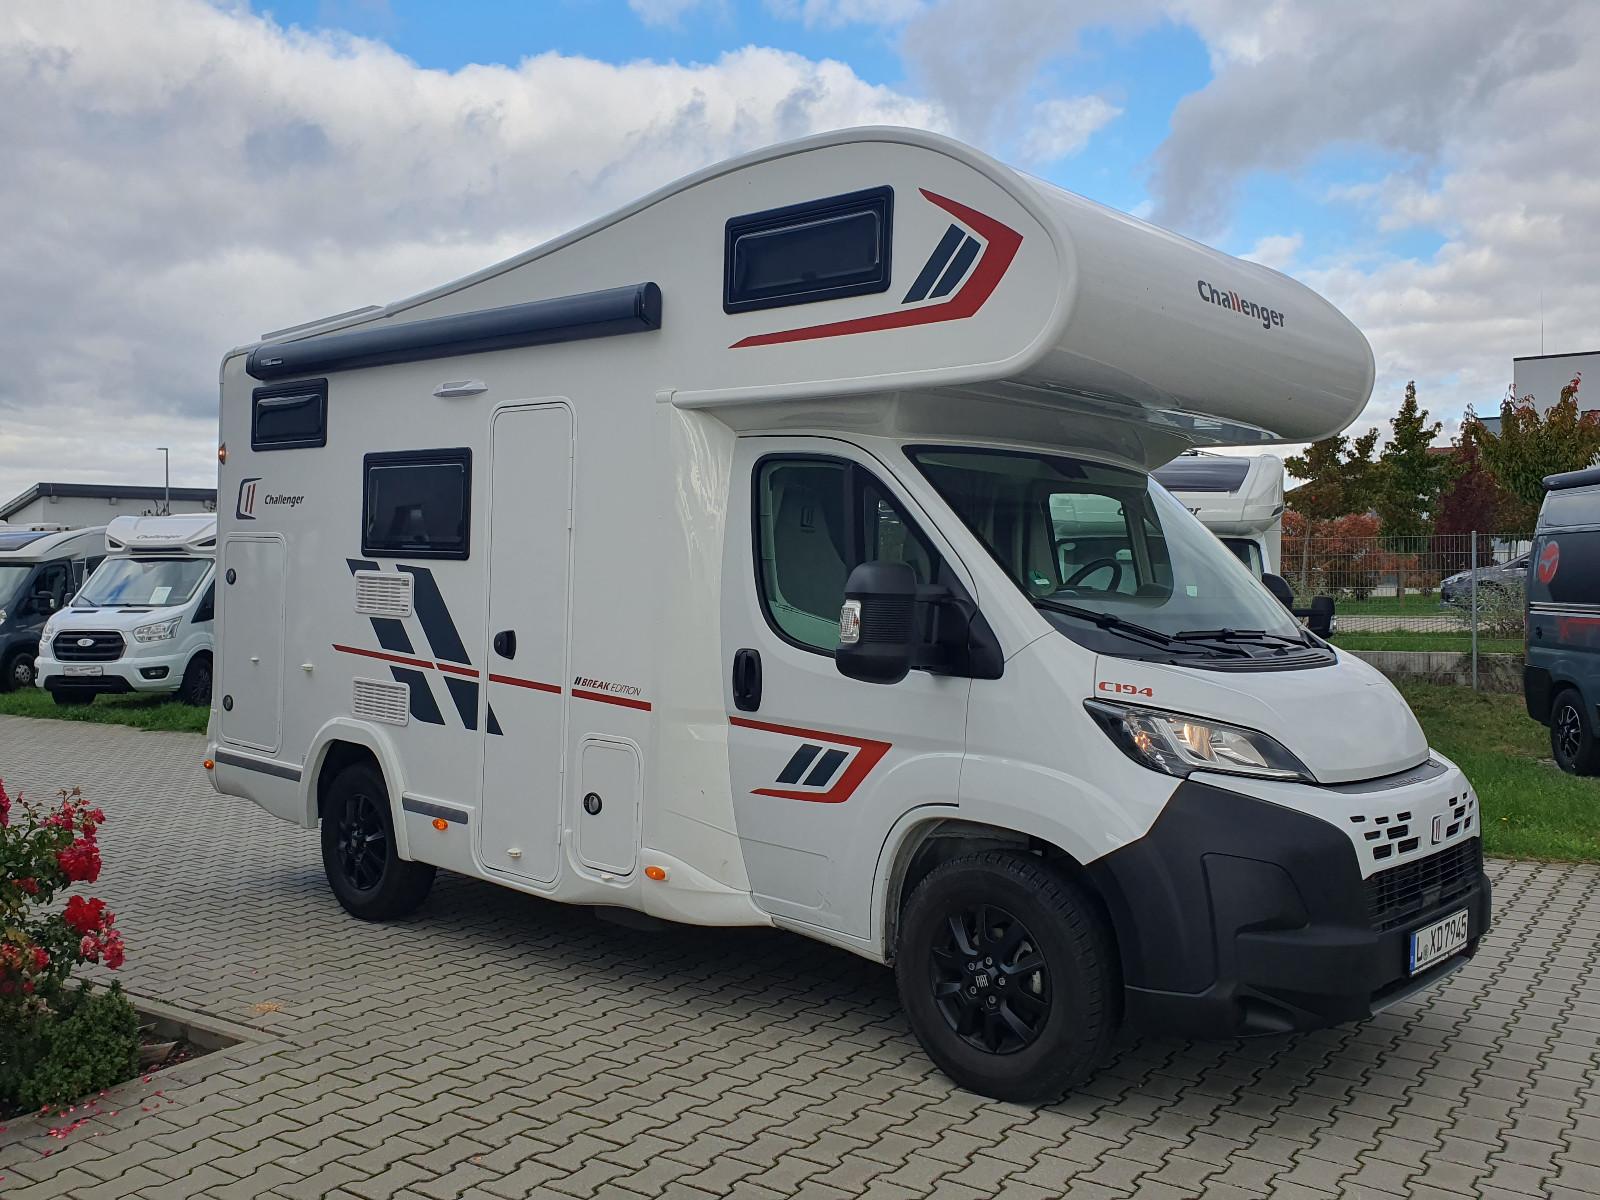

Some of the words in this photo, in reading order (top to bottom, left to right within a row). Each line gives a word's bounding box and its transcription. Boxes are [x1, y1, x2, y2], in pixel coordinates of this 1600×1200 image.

[1197, 280, 1284, 329] Challenger
[264, 494, 304, 507] Challenger
[581, 678, 610, 690] BREAK
[610, 683, 642, 696] EDITION
[1099, 681, 1153, 697] C194
